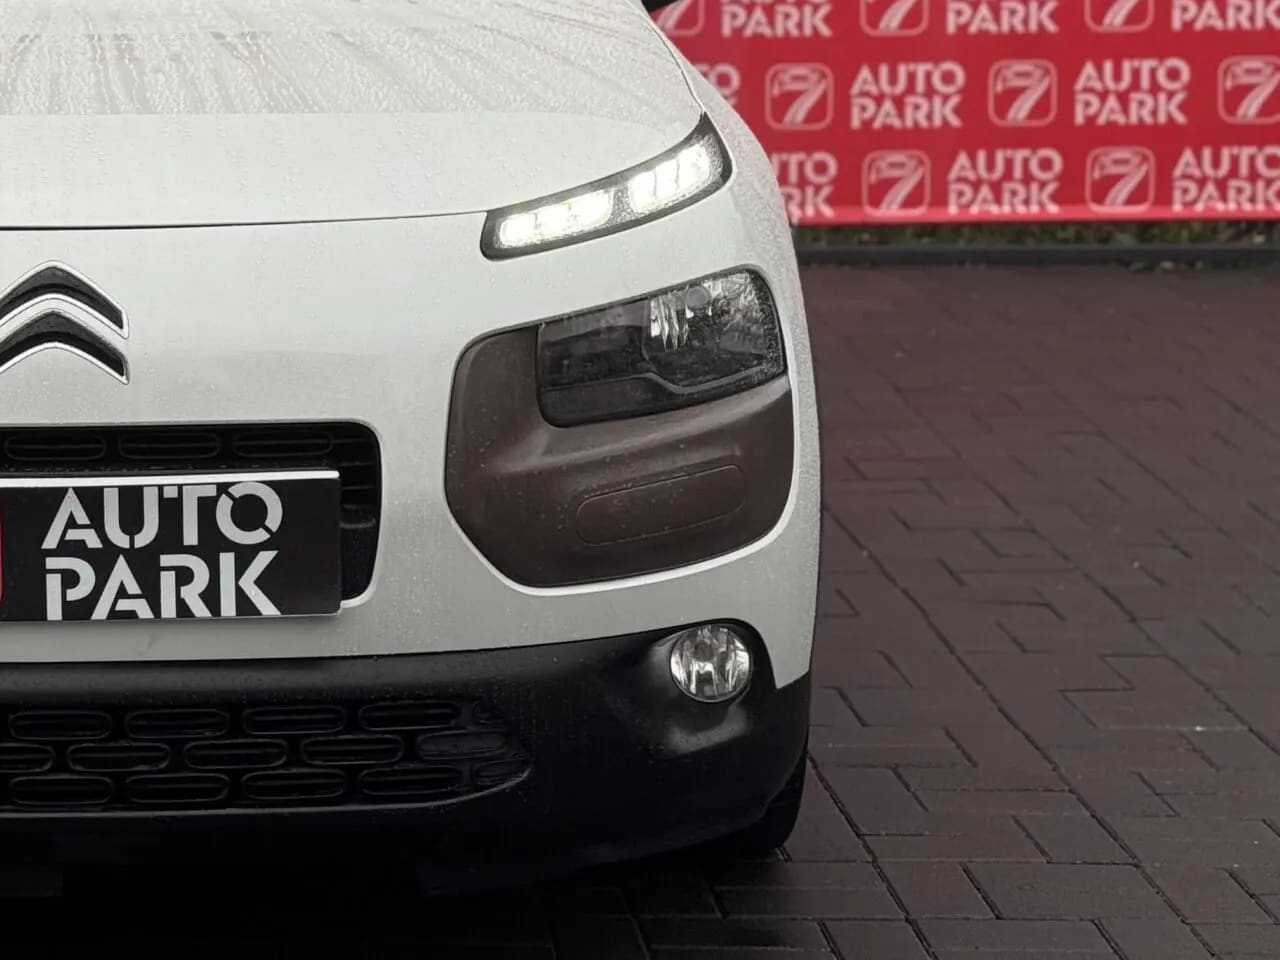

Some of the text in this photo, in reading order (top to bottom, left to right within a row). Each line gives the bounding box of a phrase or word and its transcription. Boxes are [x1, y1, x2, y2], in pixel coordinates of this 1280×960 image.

[720, 3, 832, 39] PARK
[946, 0, 1058, 35] PARK
[850, 60, 965, 96] AUTO
[1074, 57, 1189, 93] AUTO
[850, 94, 962, 130] PARK
[1074, 91, 1186, 127] PARK
[947, 147, 1062, 183] AUTO
[1173, 144, 1280, 180] AUTO
[947, 181, 1059, 217] PARK
[1173, 178, 1280, 214] PARK
[40, 481, 283, 549] AUTO
[45, 550, 281, 621] PARK
